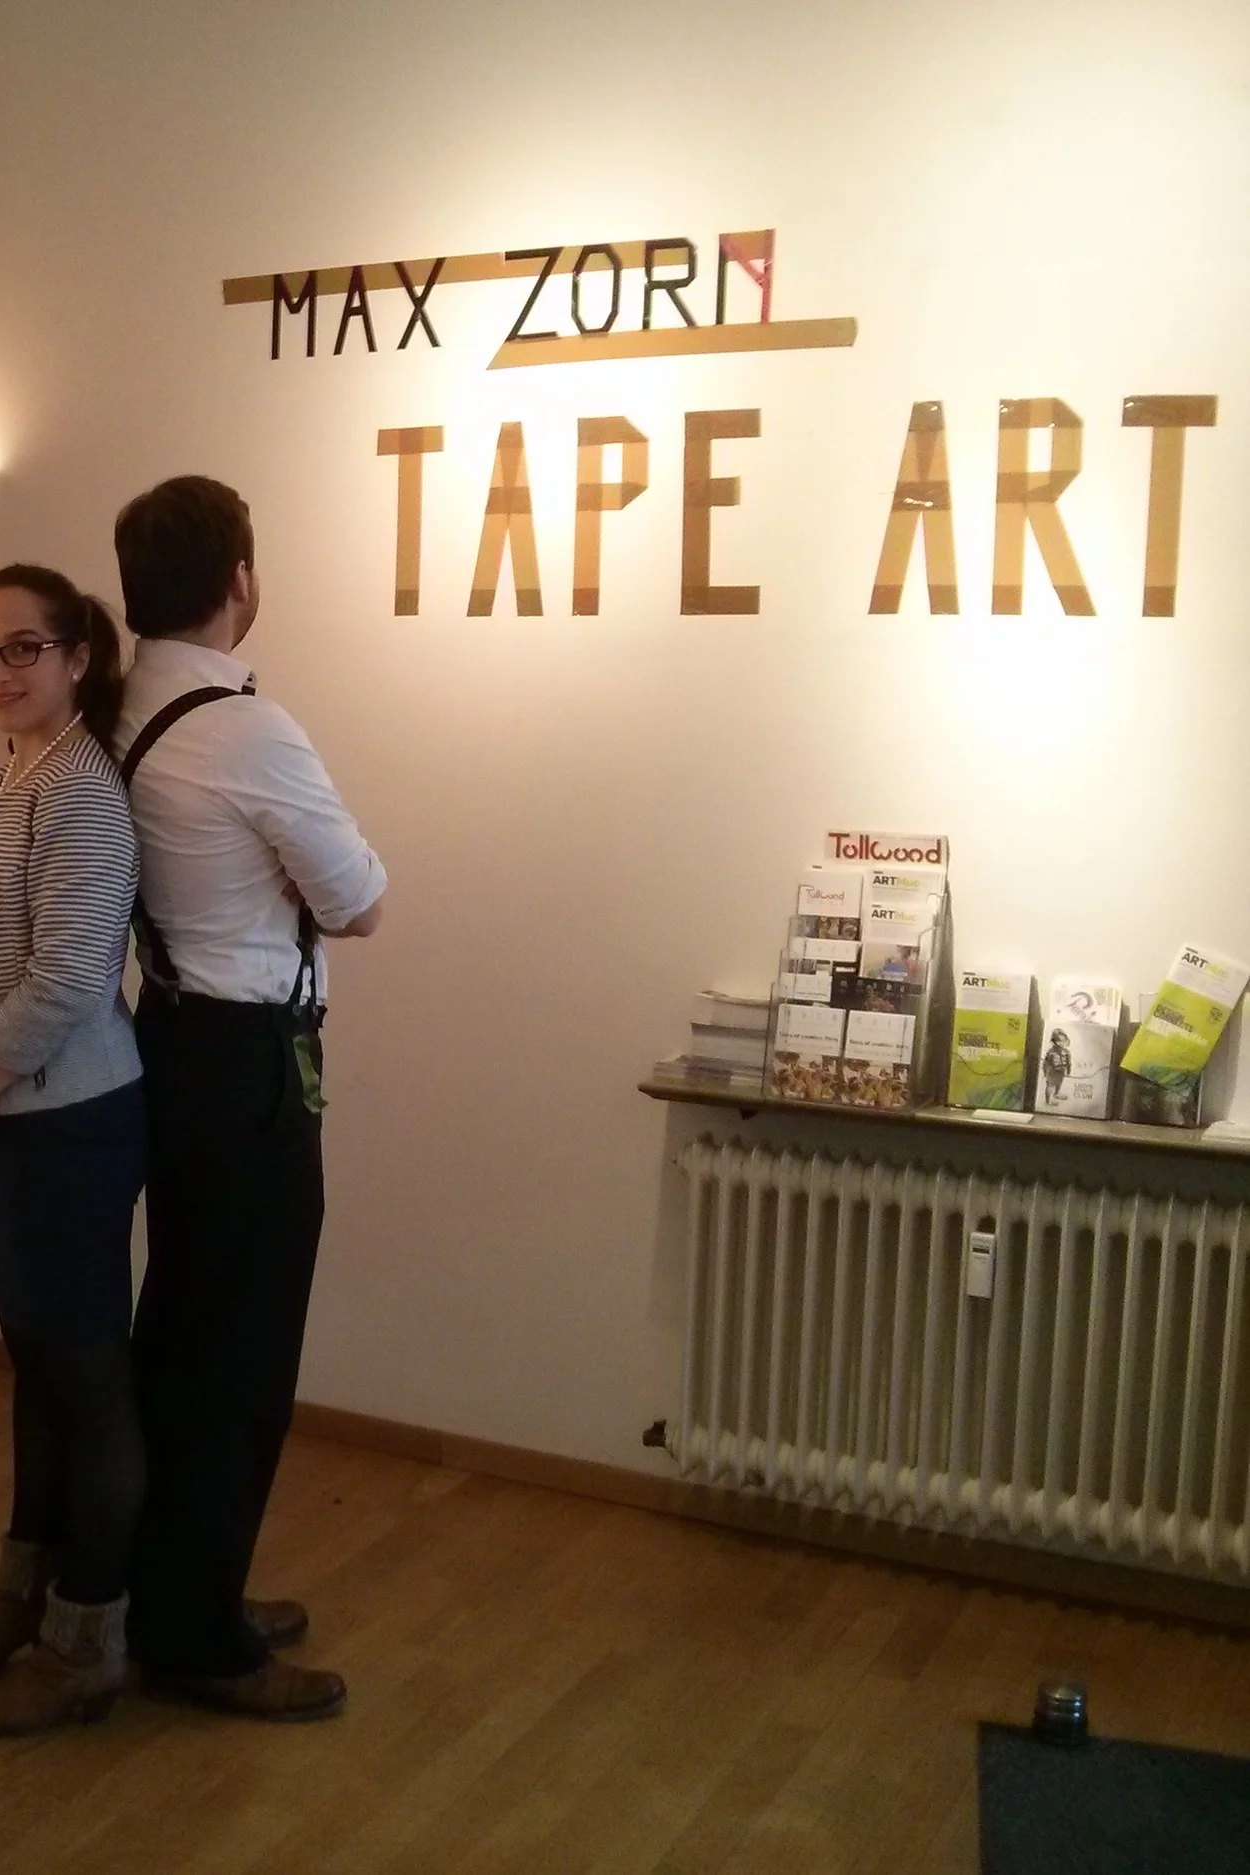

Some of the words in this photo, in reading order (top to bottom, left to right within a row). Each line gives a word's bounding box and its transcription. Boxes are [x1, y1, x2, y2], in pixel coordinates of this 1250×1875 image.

[269, 257, 445, 360] MAX
[377, 408, 762, 617] TAPE
[867, 395, 1218, 618] ART
[828, 832, 942, 865] Tollwood
